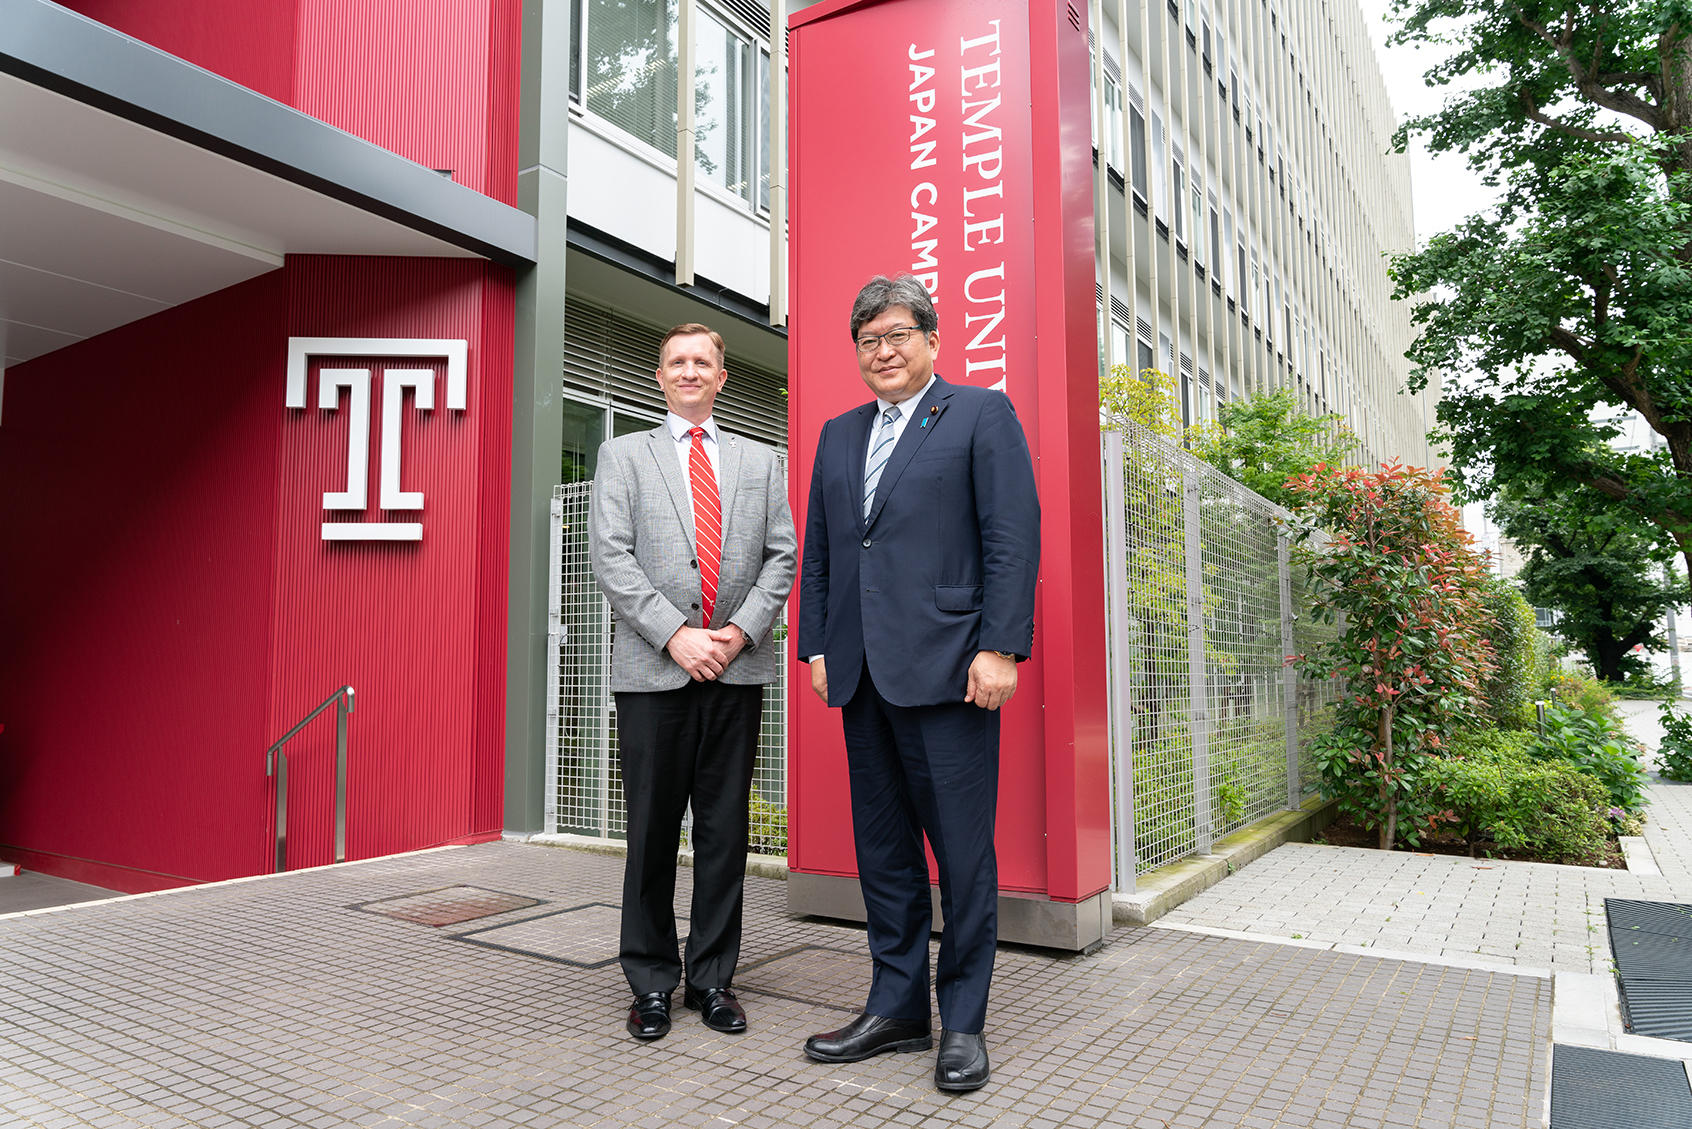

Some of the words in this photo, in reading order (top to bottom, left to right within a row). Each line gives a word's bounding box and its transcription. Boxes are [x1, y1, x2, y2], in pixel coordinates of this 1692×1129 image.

[908, 43, 937, 170] JAPAN
[960, 19, 1004, 252] TEMPLE
[910, 182, 939, 337] CAMP
[286, 336, 468, 540] T
